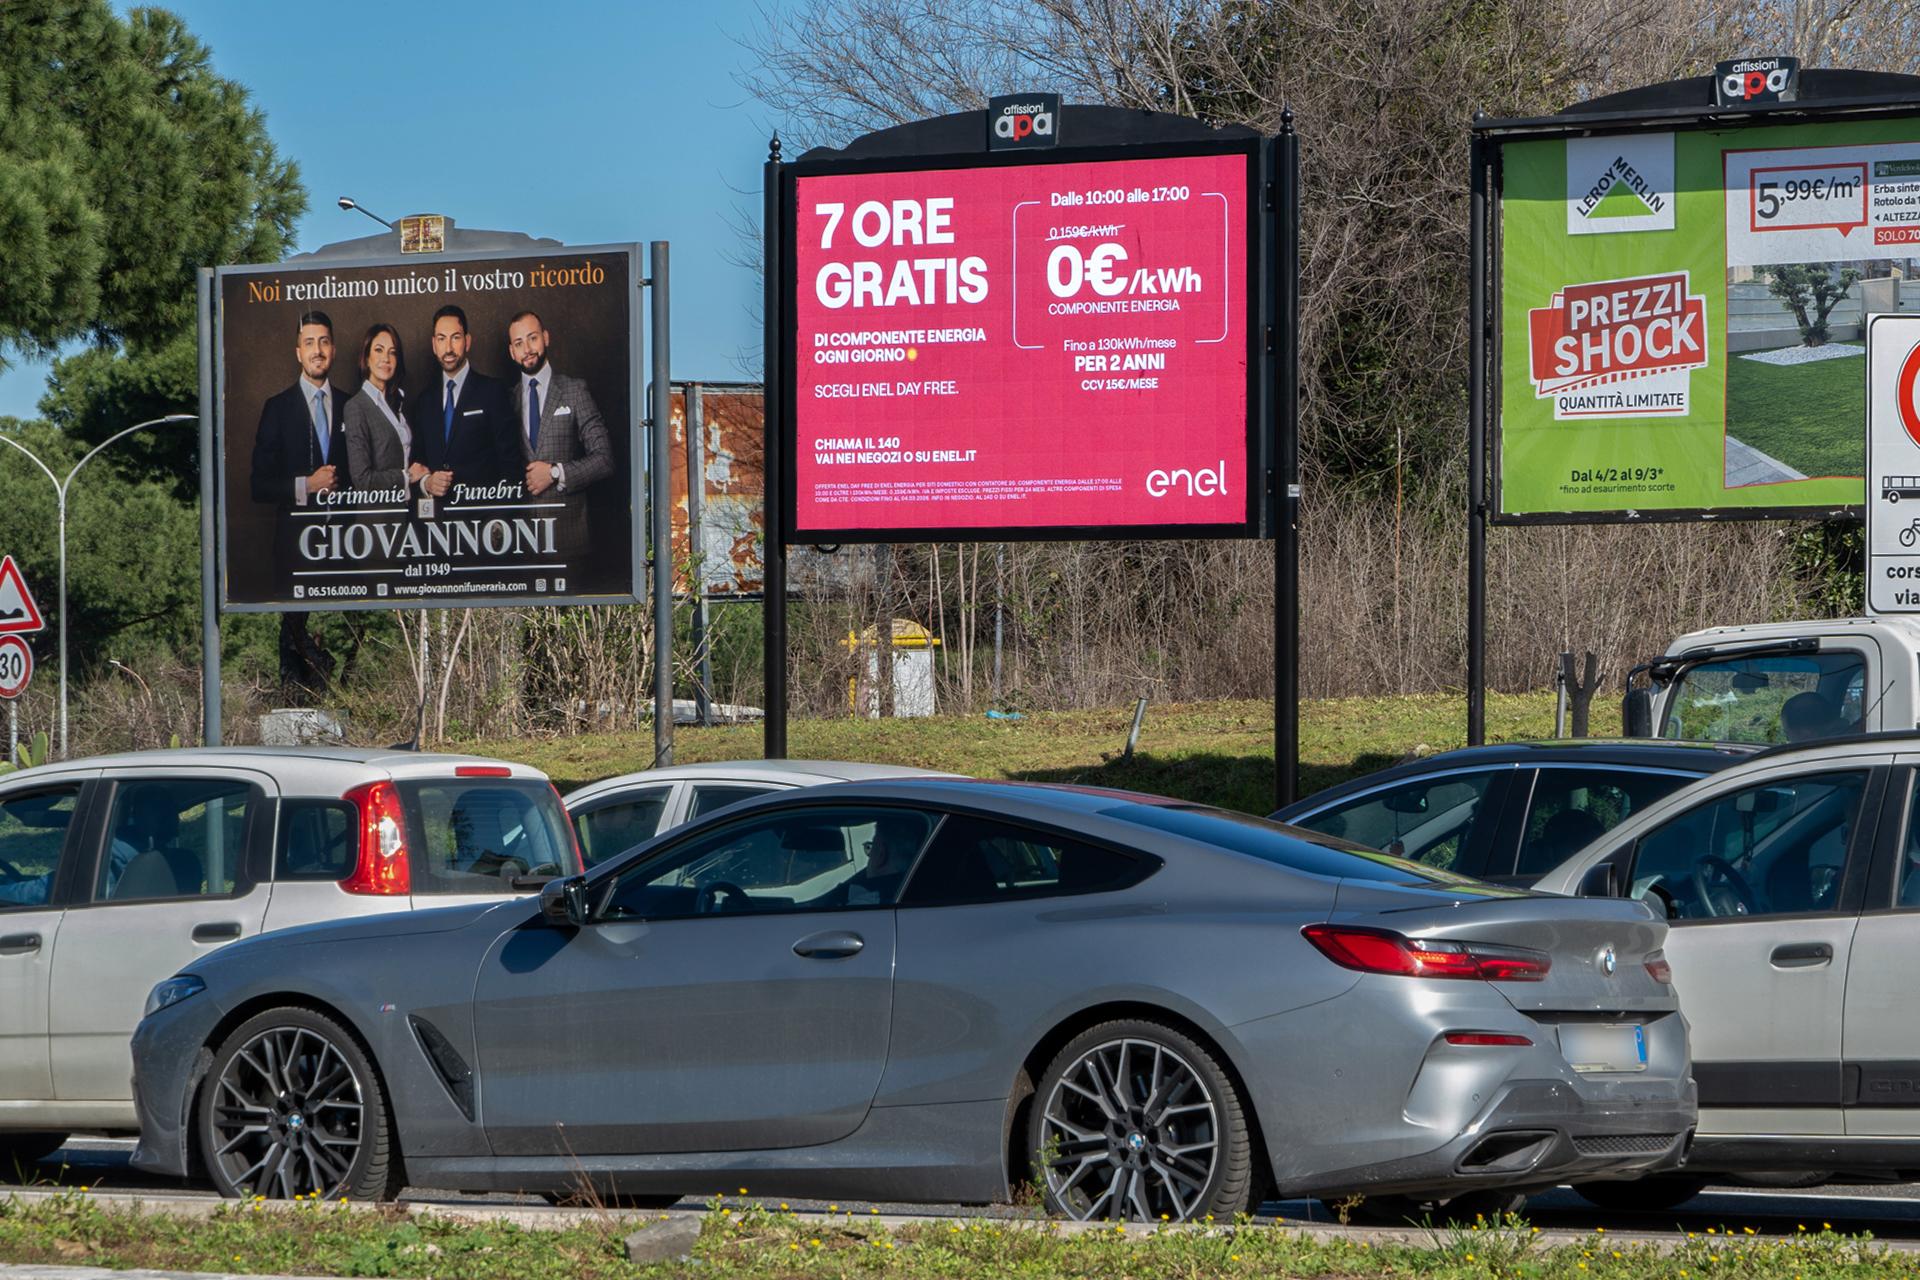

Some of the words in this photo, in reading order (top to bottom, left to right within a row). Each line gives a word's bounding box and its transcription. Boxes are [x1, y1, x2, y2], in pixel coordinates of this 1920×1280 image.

[1732, 58, 1779, 72] affissioni
[1722, 68, 1788, 100] apa
[1004, 102, 1044, 114] affissioni
[994, 112, 1052, 141] apa
[1576, 167, 1616, 216] LEROY
[1612, 156, 1664, 213] MERLIN
[1874, 184, 1895, 194] Erba
[1051, 192, 1083, 206] Dalle
[1086, 190, 1124, 204] 10:00
[1127, 188, 1150, 203] alle
[1152, 186, 1190, 202] 17:00
[1874, 196, 1904, 206] Rotolo
[1904, 196, 1916, 205] da
[816, 202, 844, 249] 7
[852, 197, 954, 248] ORE
[1878, 230, 1906, 242] SOLO
[248, 280, 280, 303] Noi
[286, 276, 378, 301] rendiamo
[384, 272, 439, 296] unico
[444, 268, 457, 292] il
[461, 268, 524, 291] vostro
[530, 261, 604, 288] ricordo
[816, 256, 988, 309] GRATIS
[1048, 301, 1128, 315] COMPONENTE
[1130, 299, 1180, 312] ENERGIA
[1570, 282, 1682, 331] PREZZI
[814, 333, 828, 346] DI
[830, 330, 926, 346] COMPONENTE
[927, 328, 986, 342] ENERGIA
[1064, 339, 1087, 352] Fino
[1088, 342, 1096, 350] a
[1098, 337, 1176, 350] 130kWh/mese
[1554, 312, 1700, 376] SHOCK
[814, 350, 849, 364] OGNI
[850, 348, 906, 363] GIORNO
[1074, 355, 1106, 372] PER
[1110, 354, 1120, 370] 2
[1122, 353, 1165, 370] ANNI
[814, 384, 860, 398] SCEGLI
[862, 383, 894, 396] ENEL
[896, 382, 921, 396] DAY
[924, 381, 960, 394] FREE.
[1081, 380, 1104, 390] CCV
[1106, 378, 1158, 390] 15€/MESE
[1560, 392, 1624, 412] QUANTITÀ
[1626, 393, 1684, 407] LIMITATE
[814, 438, 863, 450] CHIAMA
[865, 438, 876, 448] IL
[878, 437, 900, 448] 140
[815, 453, 834, 464] VAI
[836, 452, 856, 464] NEI
[857, 452, 900, 464] NEGOZI
[903, 452, 914, 462] O
[916, 451, 930, 462] SU
[932, 450, 976, 462] ENEL.IT
[1146, 460, 1228, 497] enel
[1571, 470, 1592, 482] Dal
[1596, 468, 1617, 482] 4/2
[1620, 468, 1632, 481] al
[316, 484, 406, 506] Cerimonie
[450, 479, 524, 505] Funebri
[1581, 484, 1592, 494] ad
[1593, 484, 1646, 493] esaurimento
[1648, 483, 1675, 492] scorte
[299, 518, 558, 561] GIOVANNONI
[405, 564, 422, 577] dal
[425, 563, 450, 576] 1949
[308, 585, 368, 597] 06.516.00.000
[394, 581, 528, 596] www.giovannonifuneraria.com
[1895, 588, 1920, 604] via
[0, 652, 22, 680] 30
